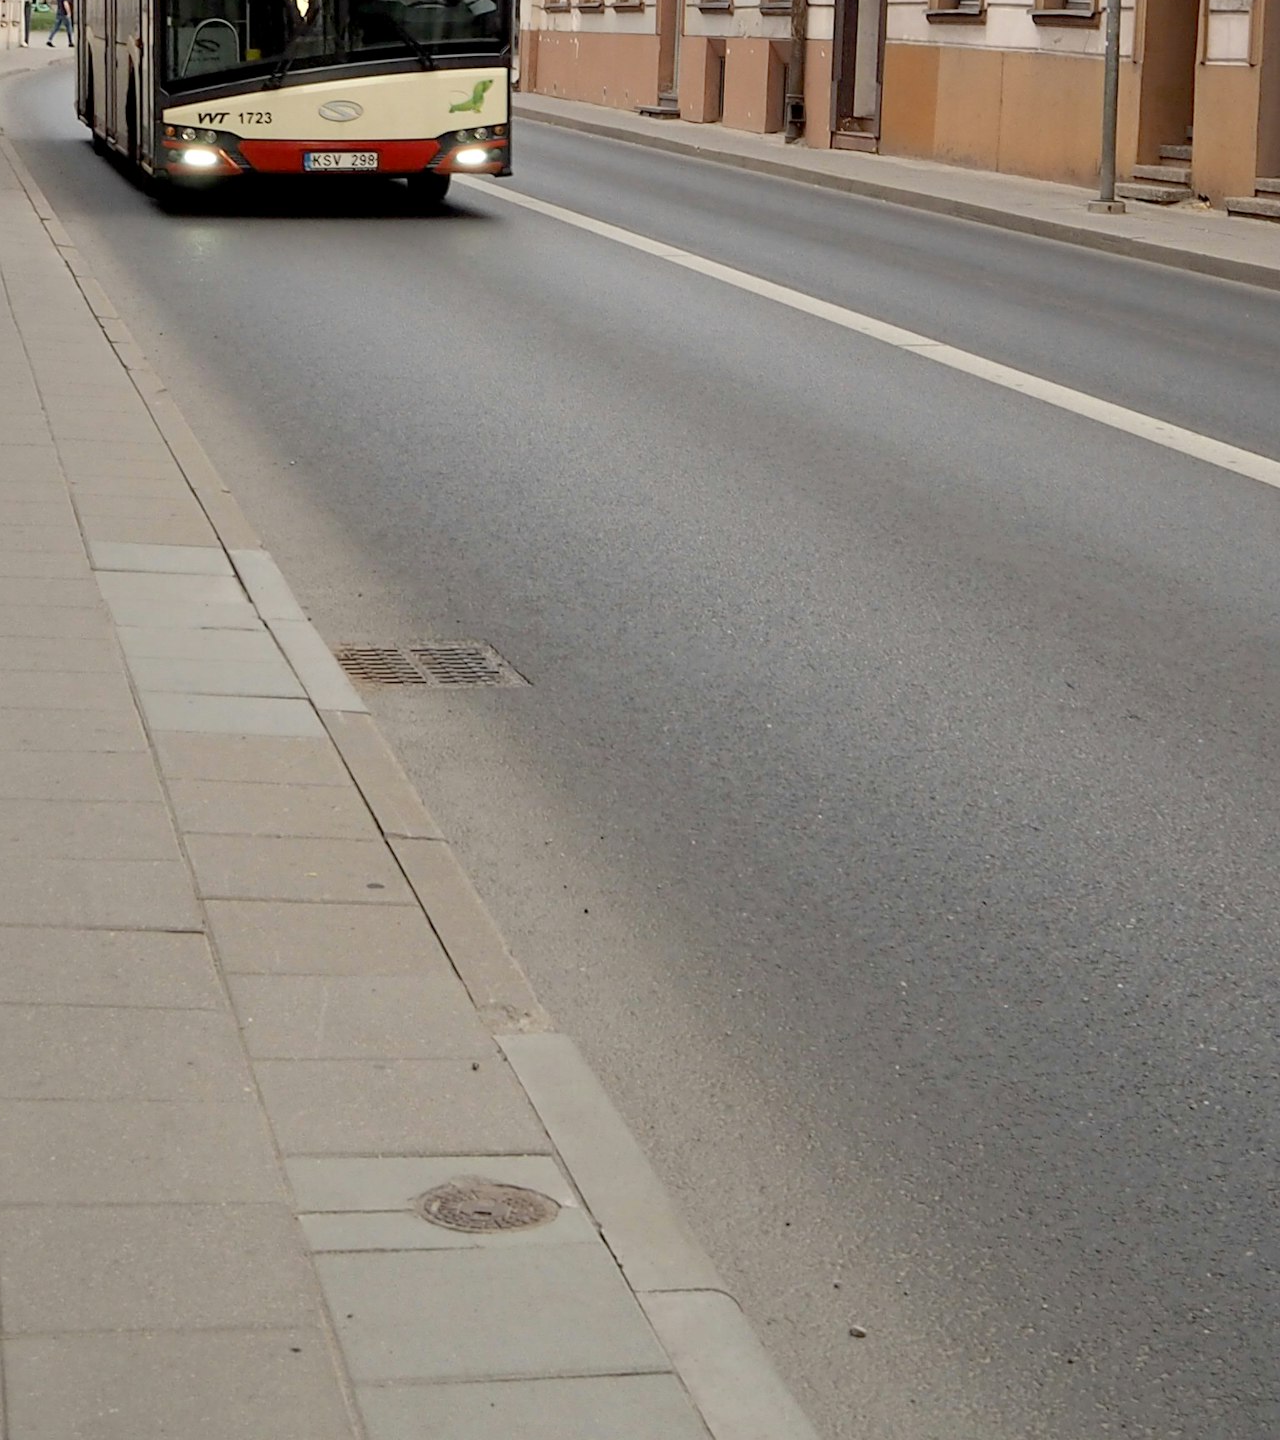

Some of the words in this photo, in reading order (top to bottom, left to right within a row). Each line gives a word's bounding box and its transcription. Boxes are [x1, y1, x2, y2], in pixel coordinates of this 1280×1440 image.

[238, 112, 273, 124] 1723
[312, 154, 342, 167] KSV
[351, 154, 376, 167] 298
